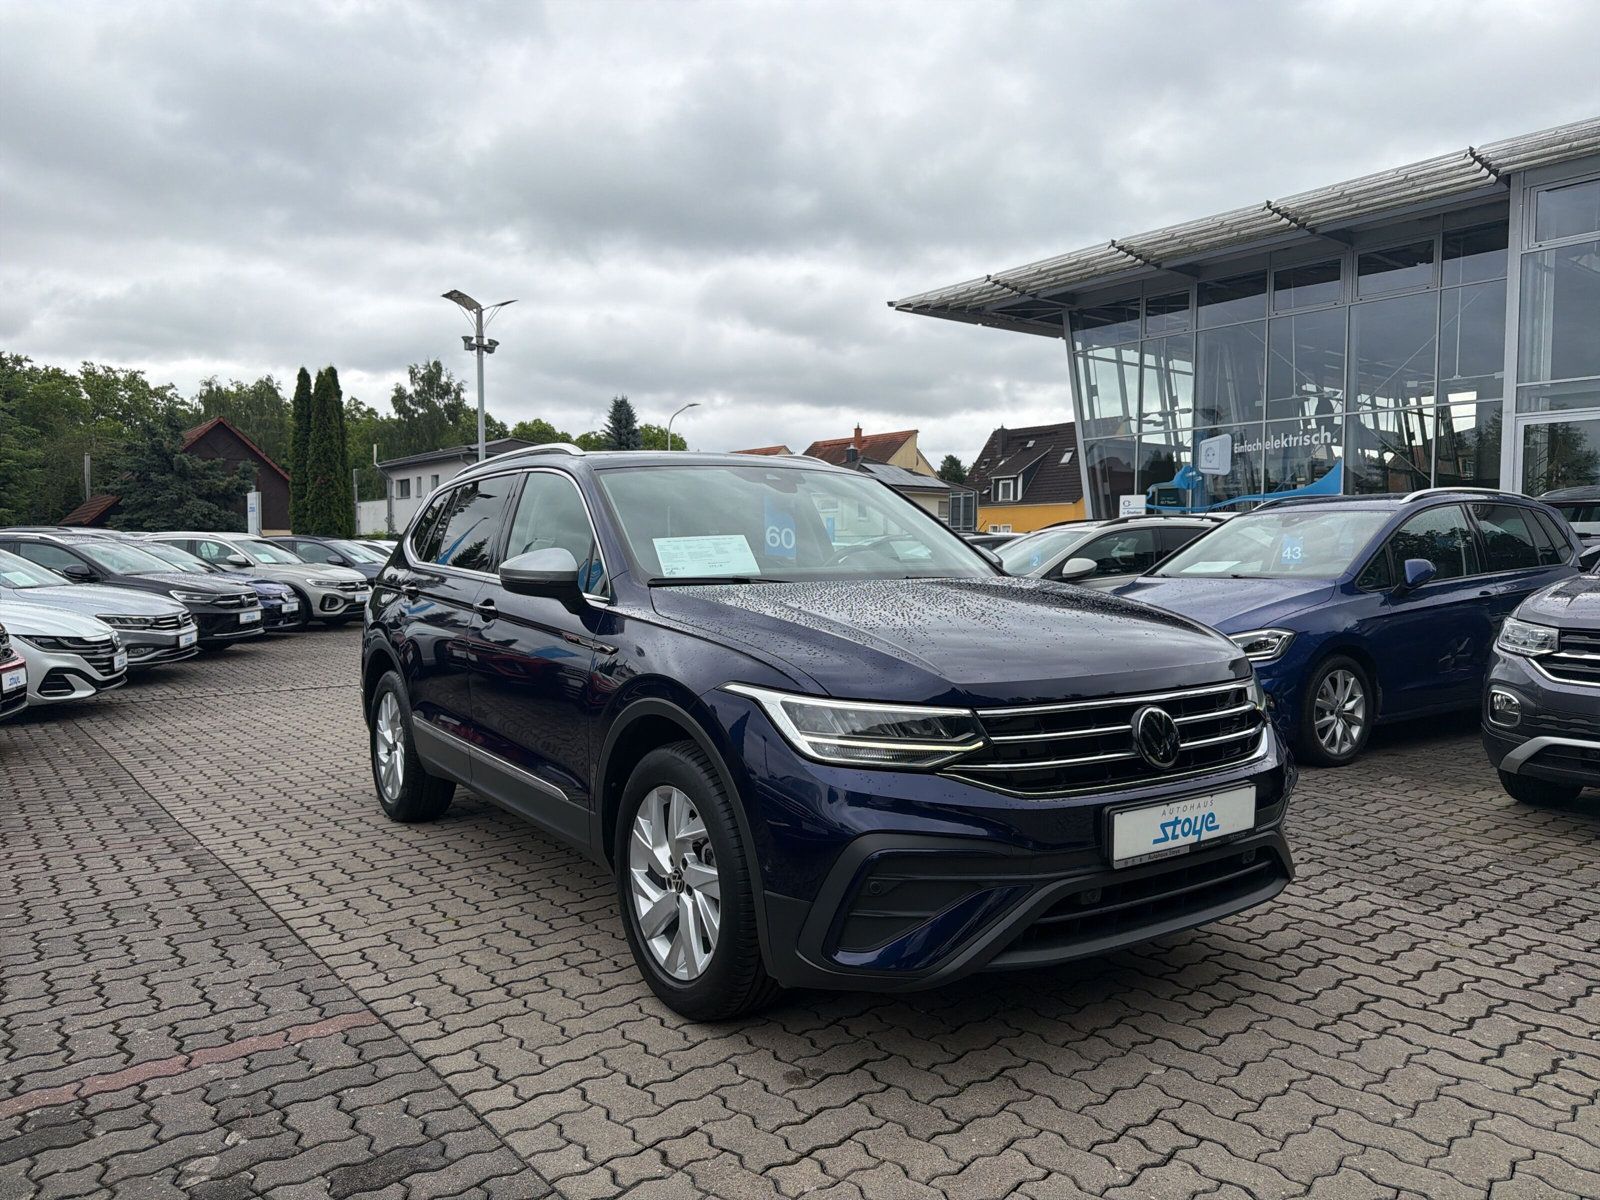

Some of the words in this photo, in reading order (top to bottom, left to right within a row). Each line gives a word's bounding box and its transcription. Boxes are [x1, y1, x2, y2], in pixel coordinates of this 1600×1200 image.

[1265, 425, 1338, 450] elektrisch.
[766, 526, 796, 549] 60
[1282, 546, 1302, 560] 43
[1161, 799, 1215, 817] AUTOHAUS
